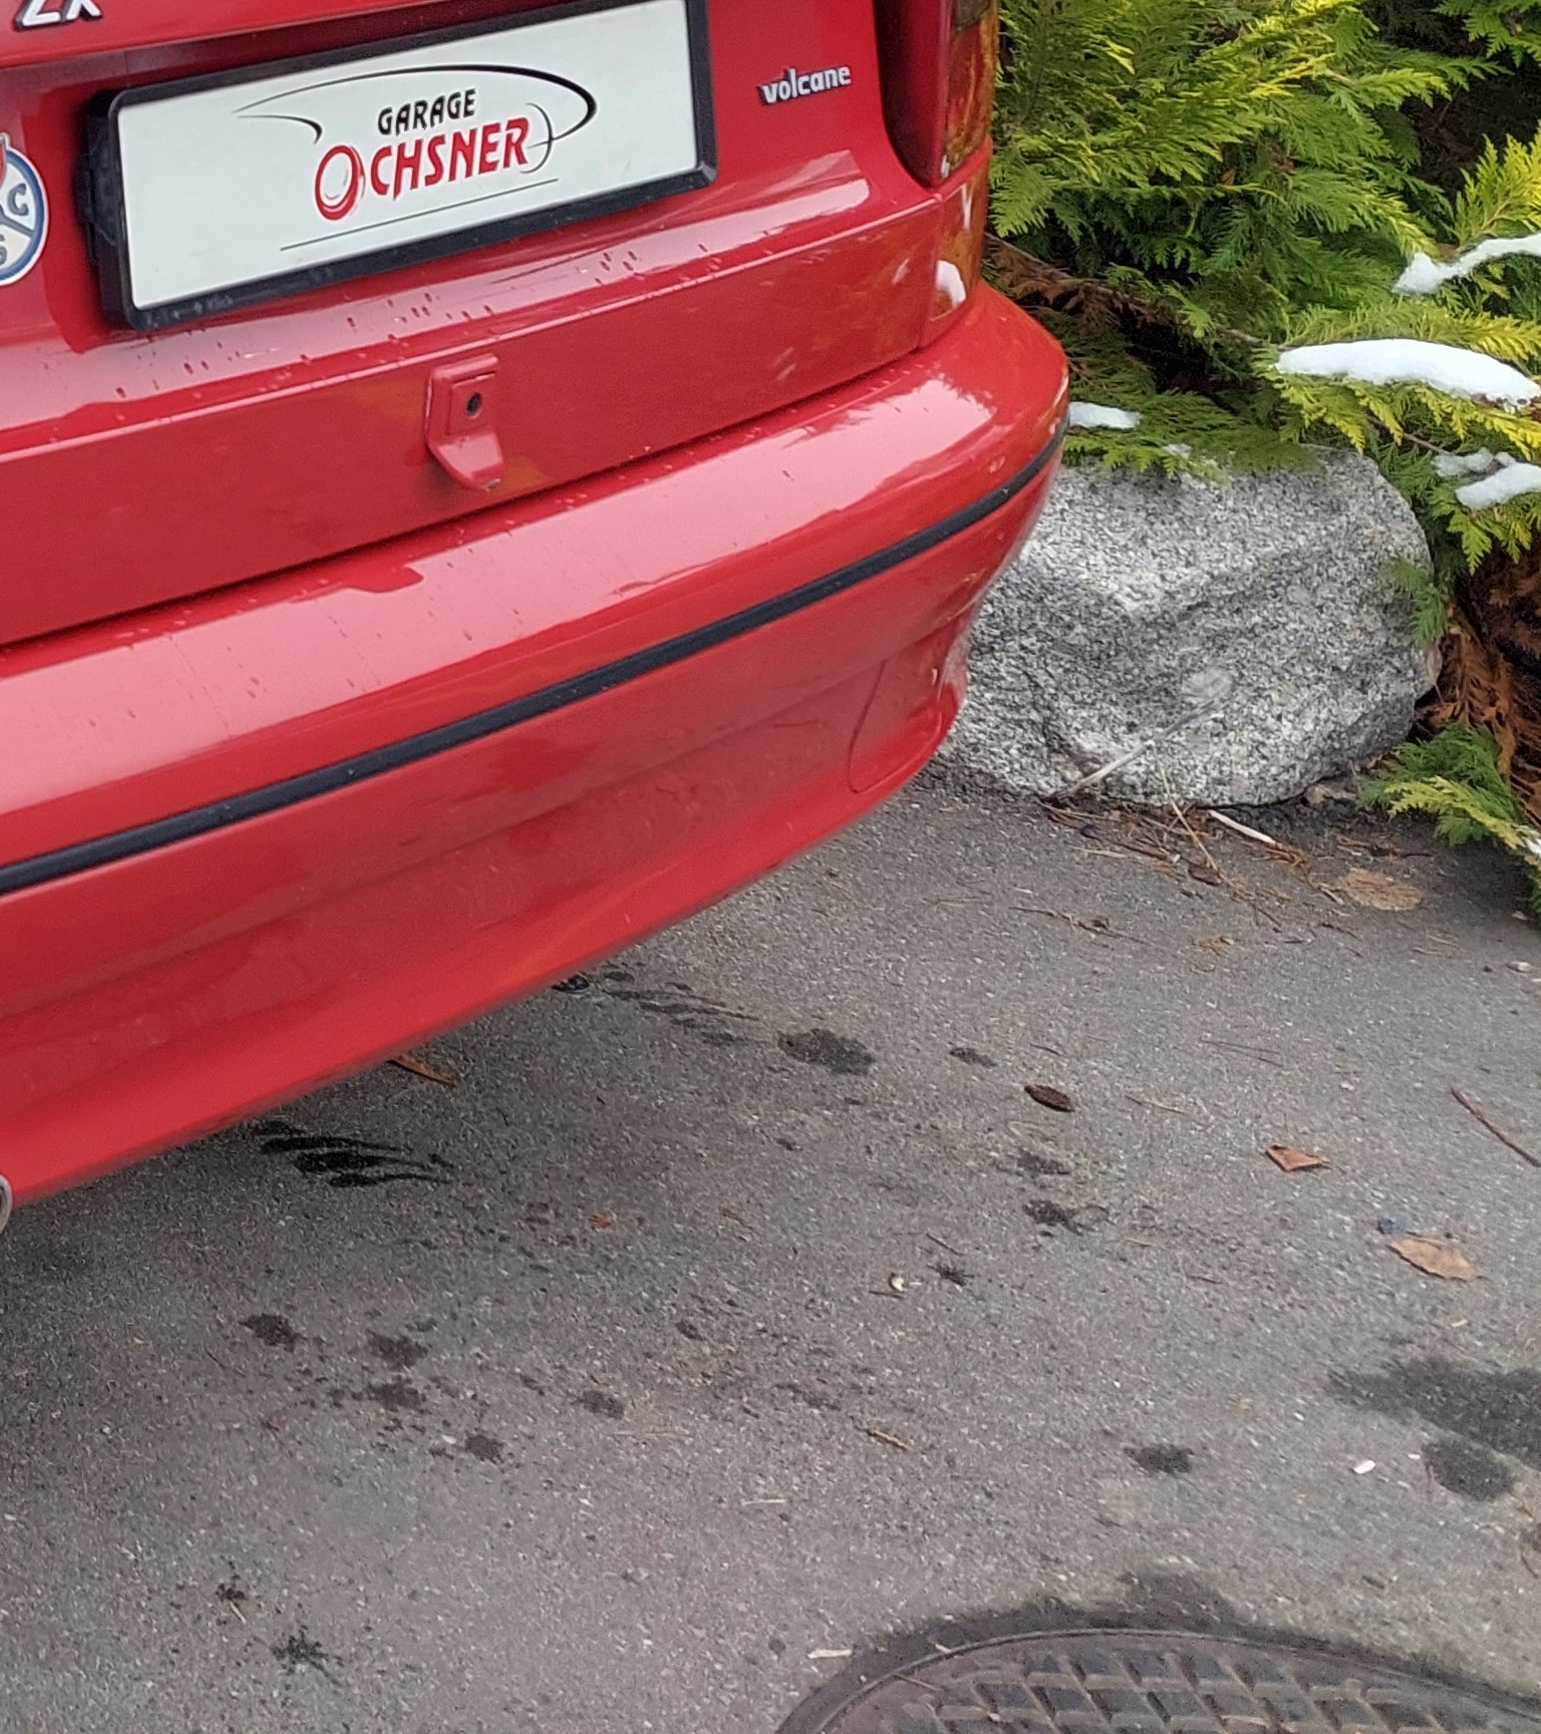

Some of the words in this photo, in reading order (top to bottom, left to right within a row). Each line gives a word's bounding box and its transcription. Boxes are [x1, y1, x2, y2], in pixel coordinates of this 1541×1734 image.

[759, 65, 852, 105] volcane
[377, 89, 476, 135] GARAGE
[315, 116, 530, 221] OCHSNER
